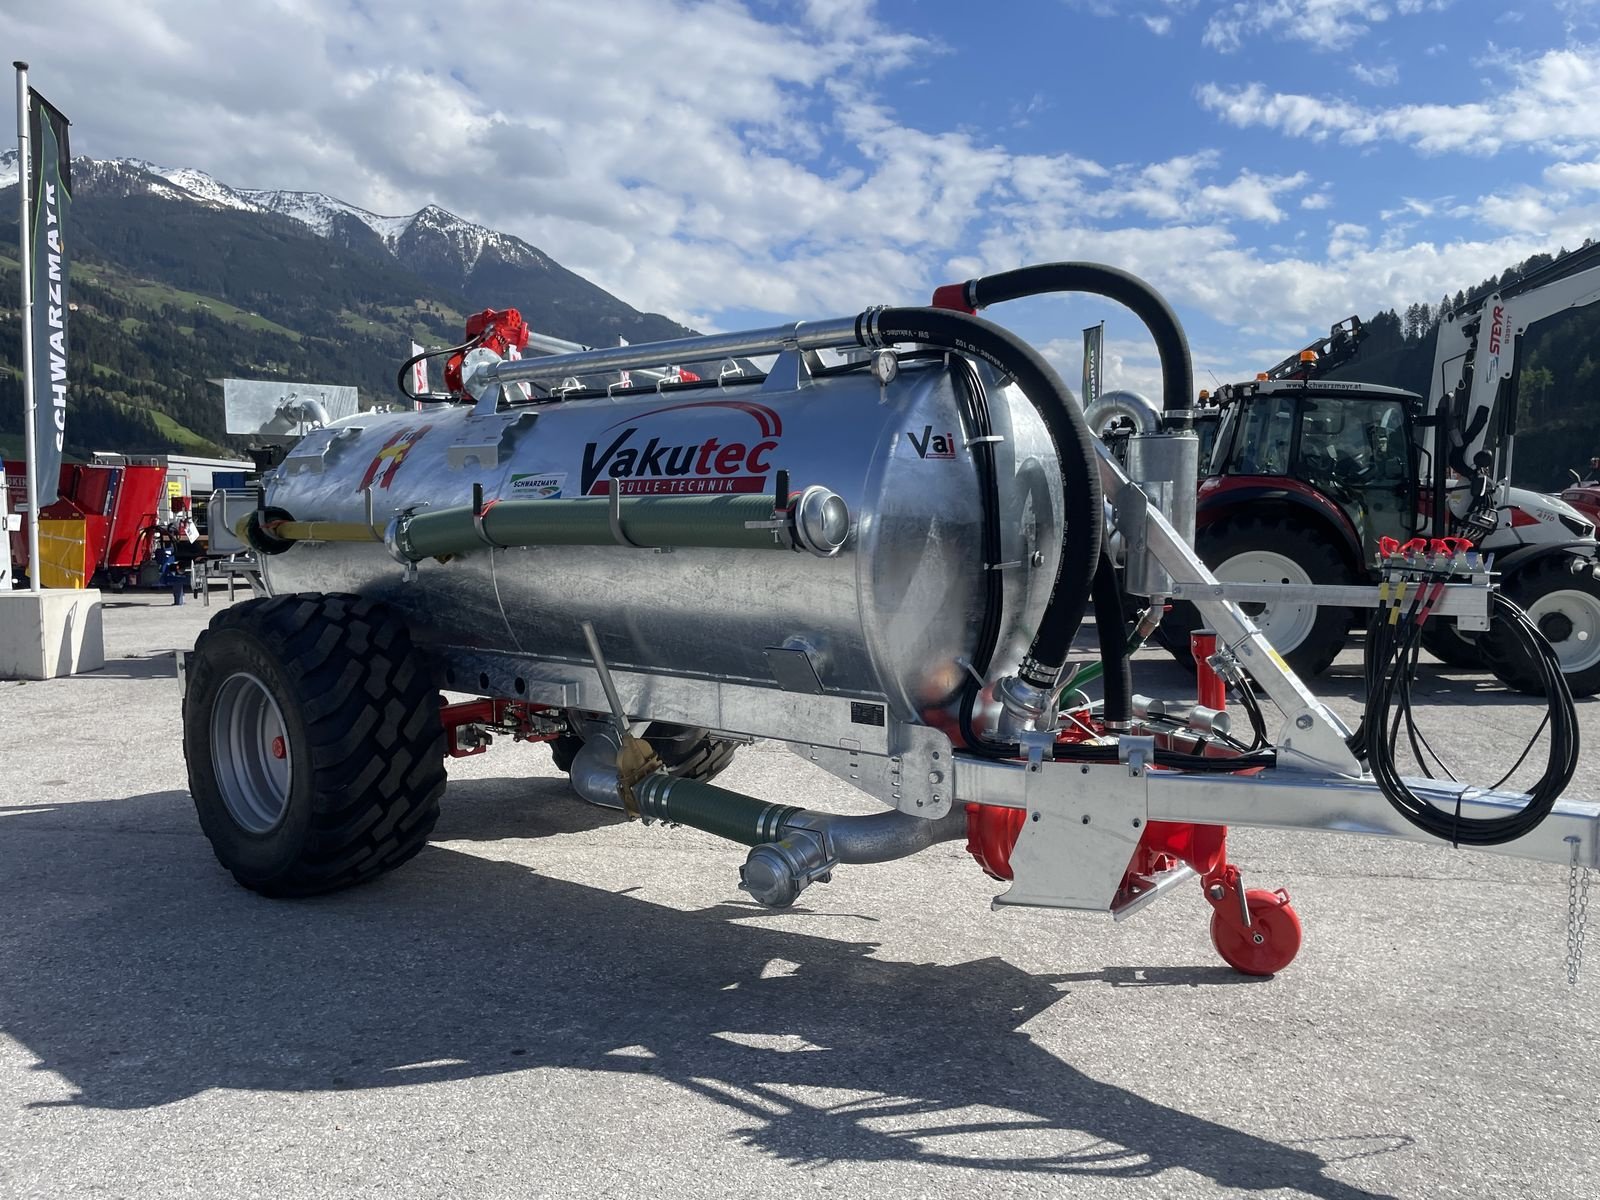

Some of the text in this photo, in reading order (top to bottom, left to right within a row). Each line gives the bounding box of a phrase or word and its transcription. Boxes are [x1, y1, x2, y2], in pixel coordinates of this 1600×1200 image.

[45, 182, 67, 453] SCHWARZMAYR
[1489, 305, 1504, 356] STEYR
[955, 338, 968, 349] 102
[979, 350, 1005, 371] Vakutec
[581, 428, 779, 496] Vakutec
[513, 479, 558, 488] SCHWARZMAYR
[619, 479, 735, 494] GÜLLE-TECHNIK
